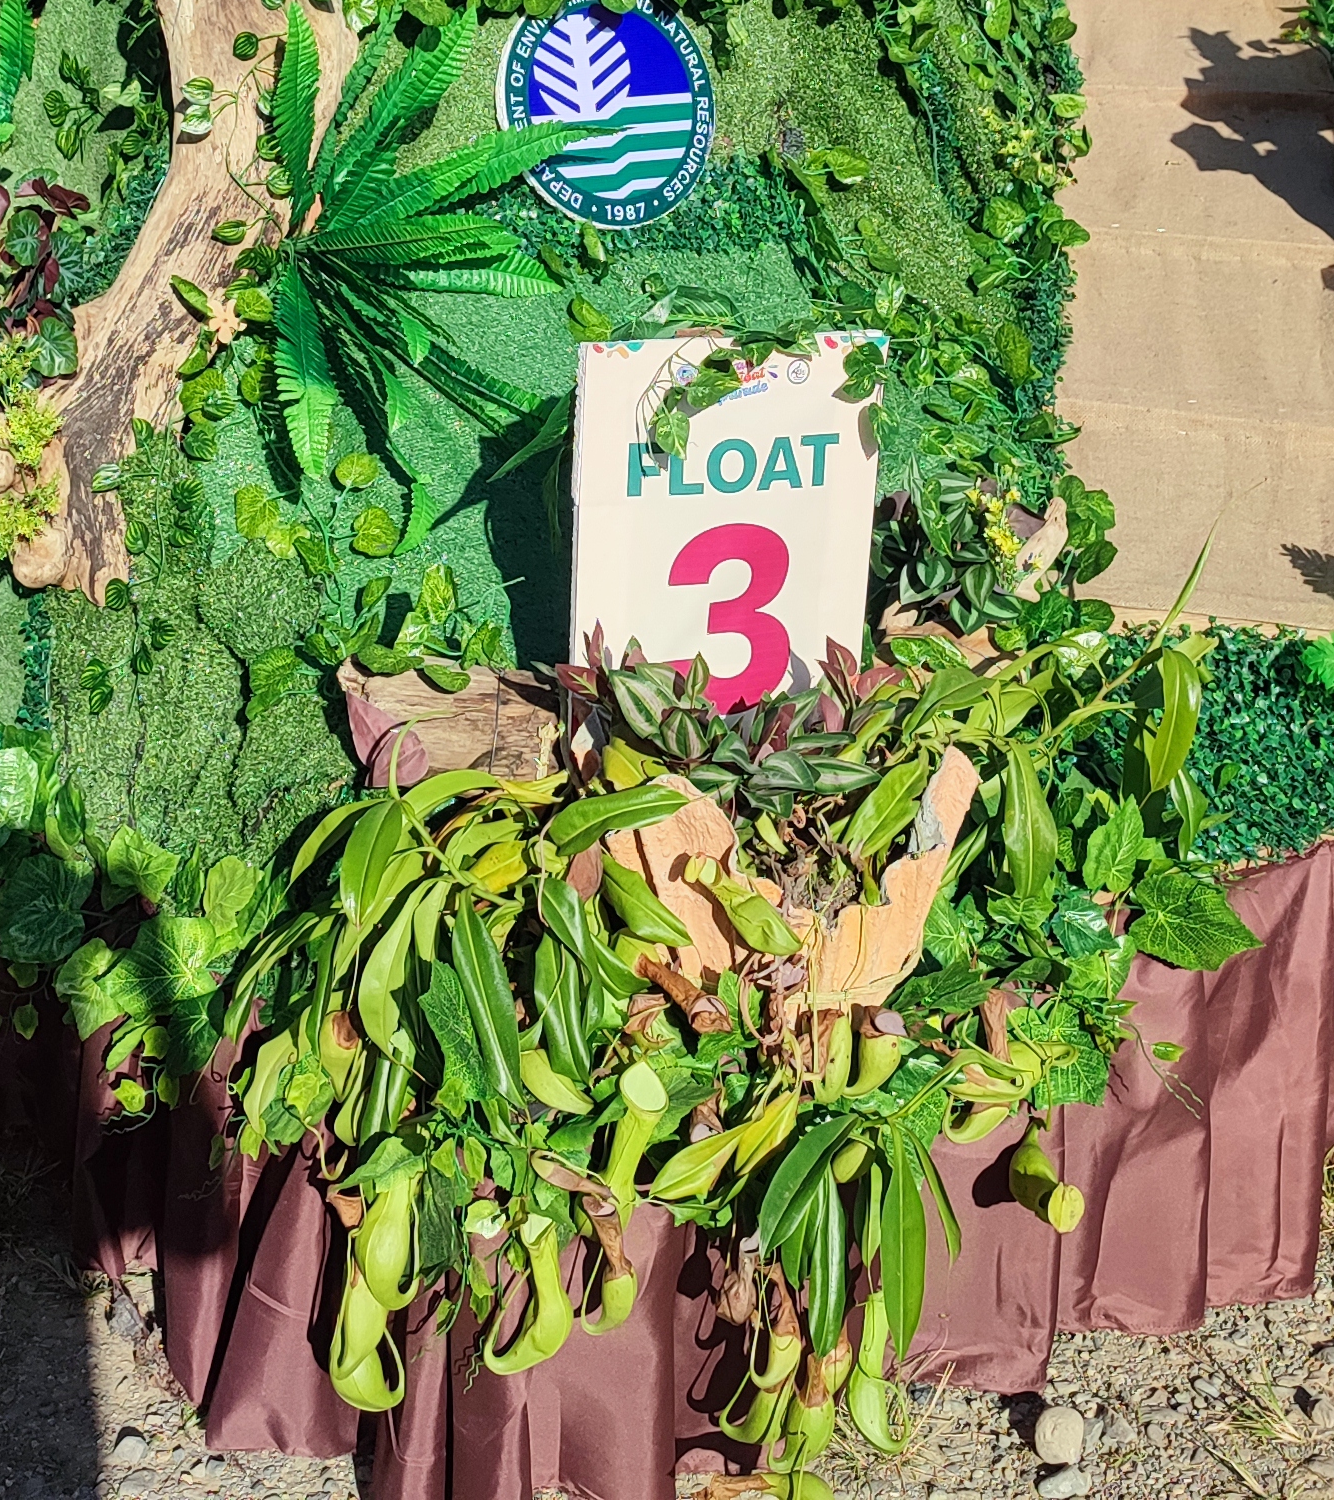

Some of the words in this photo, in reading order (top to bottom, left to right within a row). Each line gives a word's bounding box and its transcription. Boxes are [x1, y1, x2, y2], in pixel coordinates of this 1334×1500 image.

[510, 59, 527, 87] OF
[657, 9, 706, 92] NATURAL
[510, 93, 584, 210] DEPAENT
[662, 96, 709, 202] RESOURCES
[604, 201, 646, 221] 1987
[627, 432, 840, 497] FLOAT
[663, 523, 790, 716] 3
